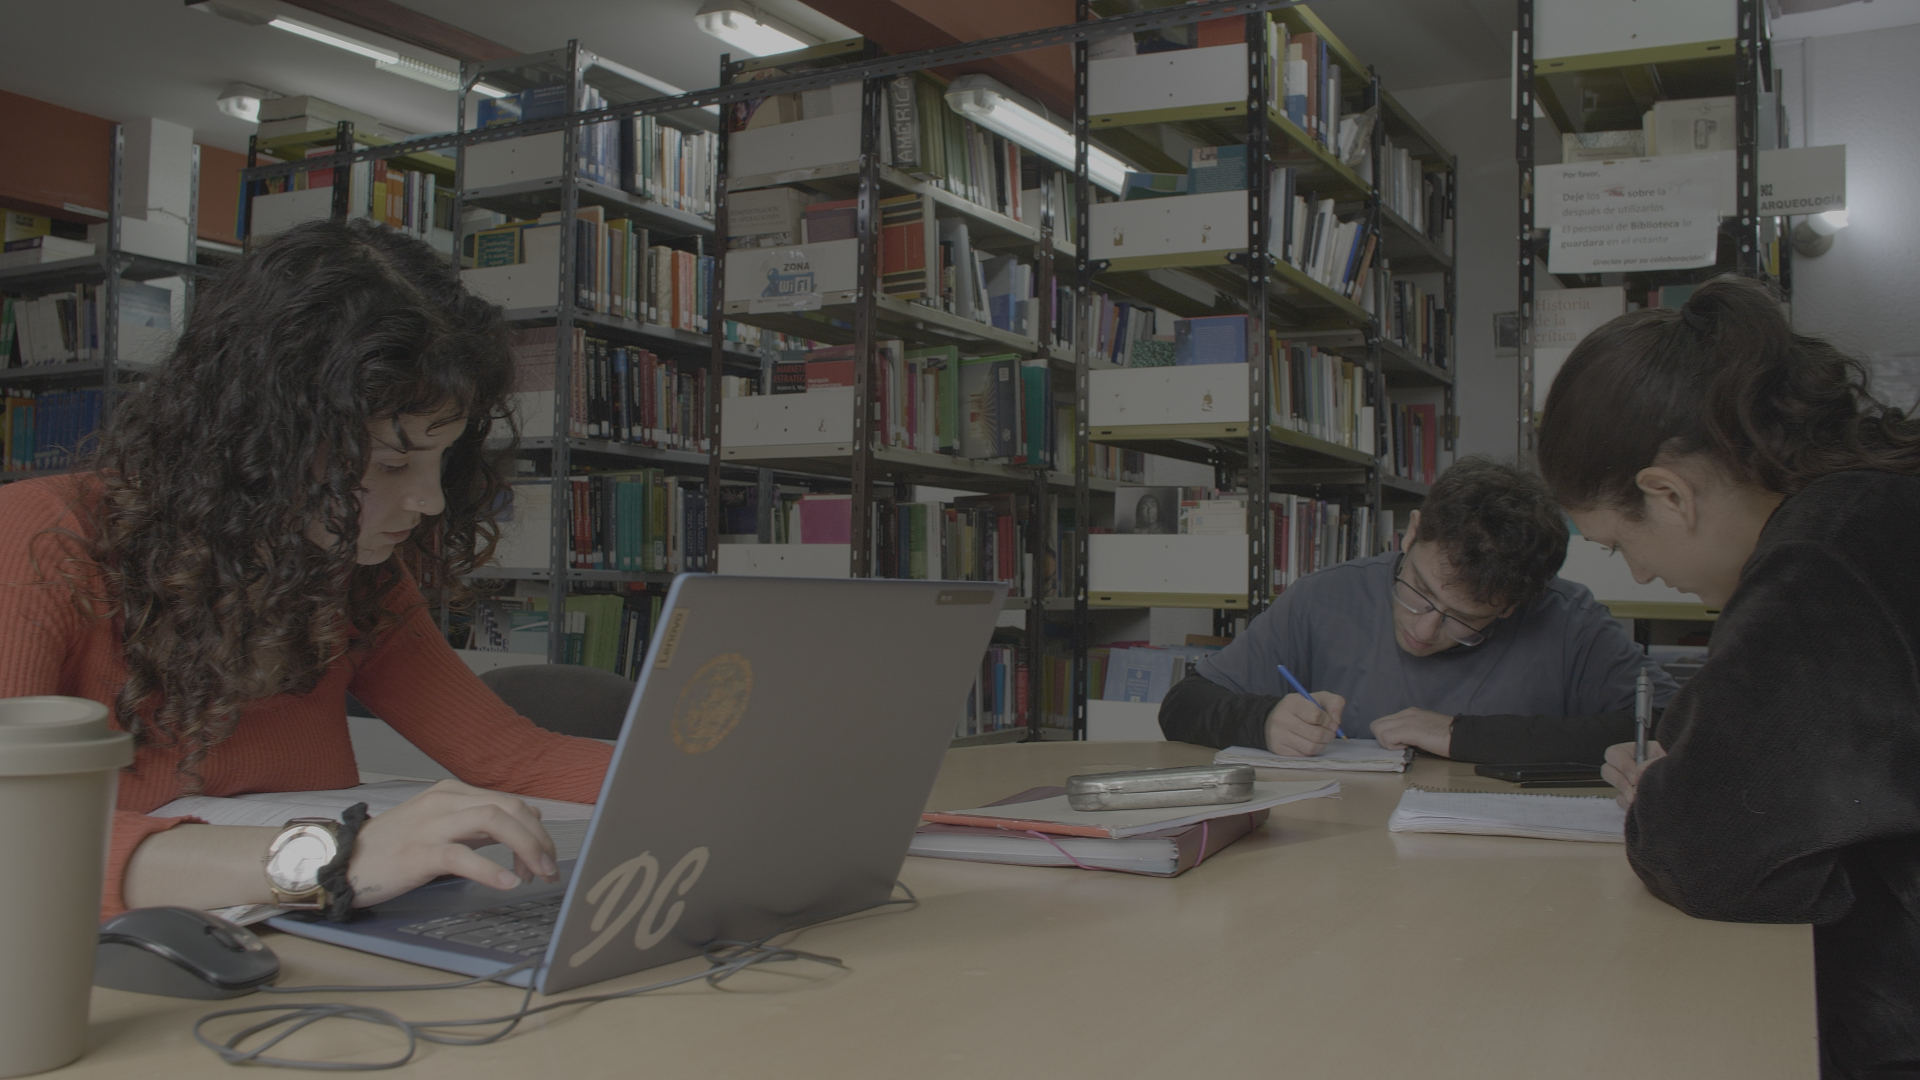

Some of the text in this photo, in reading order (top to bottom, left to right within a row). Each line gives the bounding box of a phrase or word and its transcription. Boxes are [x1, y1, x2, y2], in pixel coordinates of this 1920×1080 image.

[892, 76, 913, 164] AMÉRICA
[1578, 171, 1600, 179] favor,
[1563, 193, 1584, 203] Deje
[1587, 192, 1600, 200] los
[1627, 189, 1655, 198] sobre
[1658, 188, 1666, 196] la
[1760, 184, 1773, 197] 902
[1760, 194, 1843, 211] ARQUEOLOGÍA
[1562, 204, 1666, 218] después de utilizarlos.
[1562, 219, 1692, 234] El personal de Biblioteca lo
[1560, 239, 1604, 249] guardara
[1621, 237, 1630, 245] el
[1632, 236, 1669, 245] estante
[1592, 258, 1622, 266] Gracias
[1624, 258, 1638, 266] por
[1650, 253, 1706, 263] colaboración!
[784, 262, 810, 272] ZONA
[1535, 297, 1590, 312] Historia
[1535, 314, 1566, 326] de la
[1534, 330, 1576, 342] crítica
[658, 612, 684, 663] Lenovo
[568, 846, 710, 968] DC
